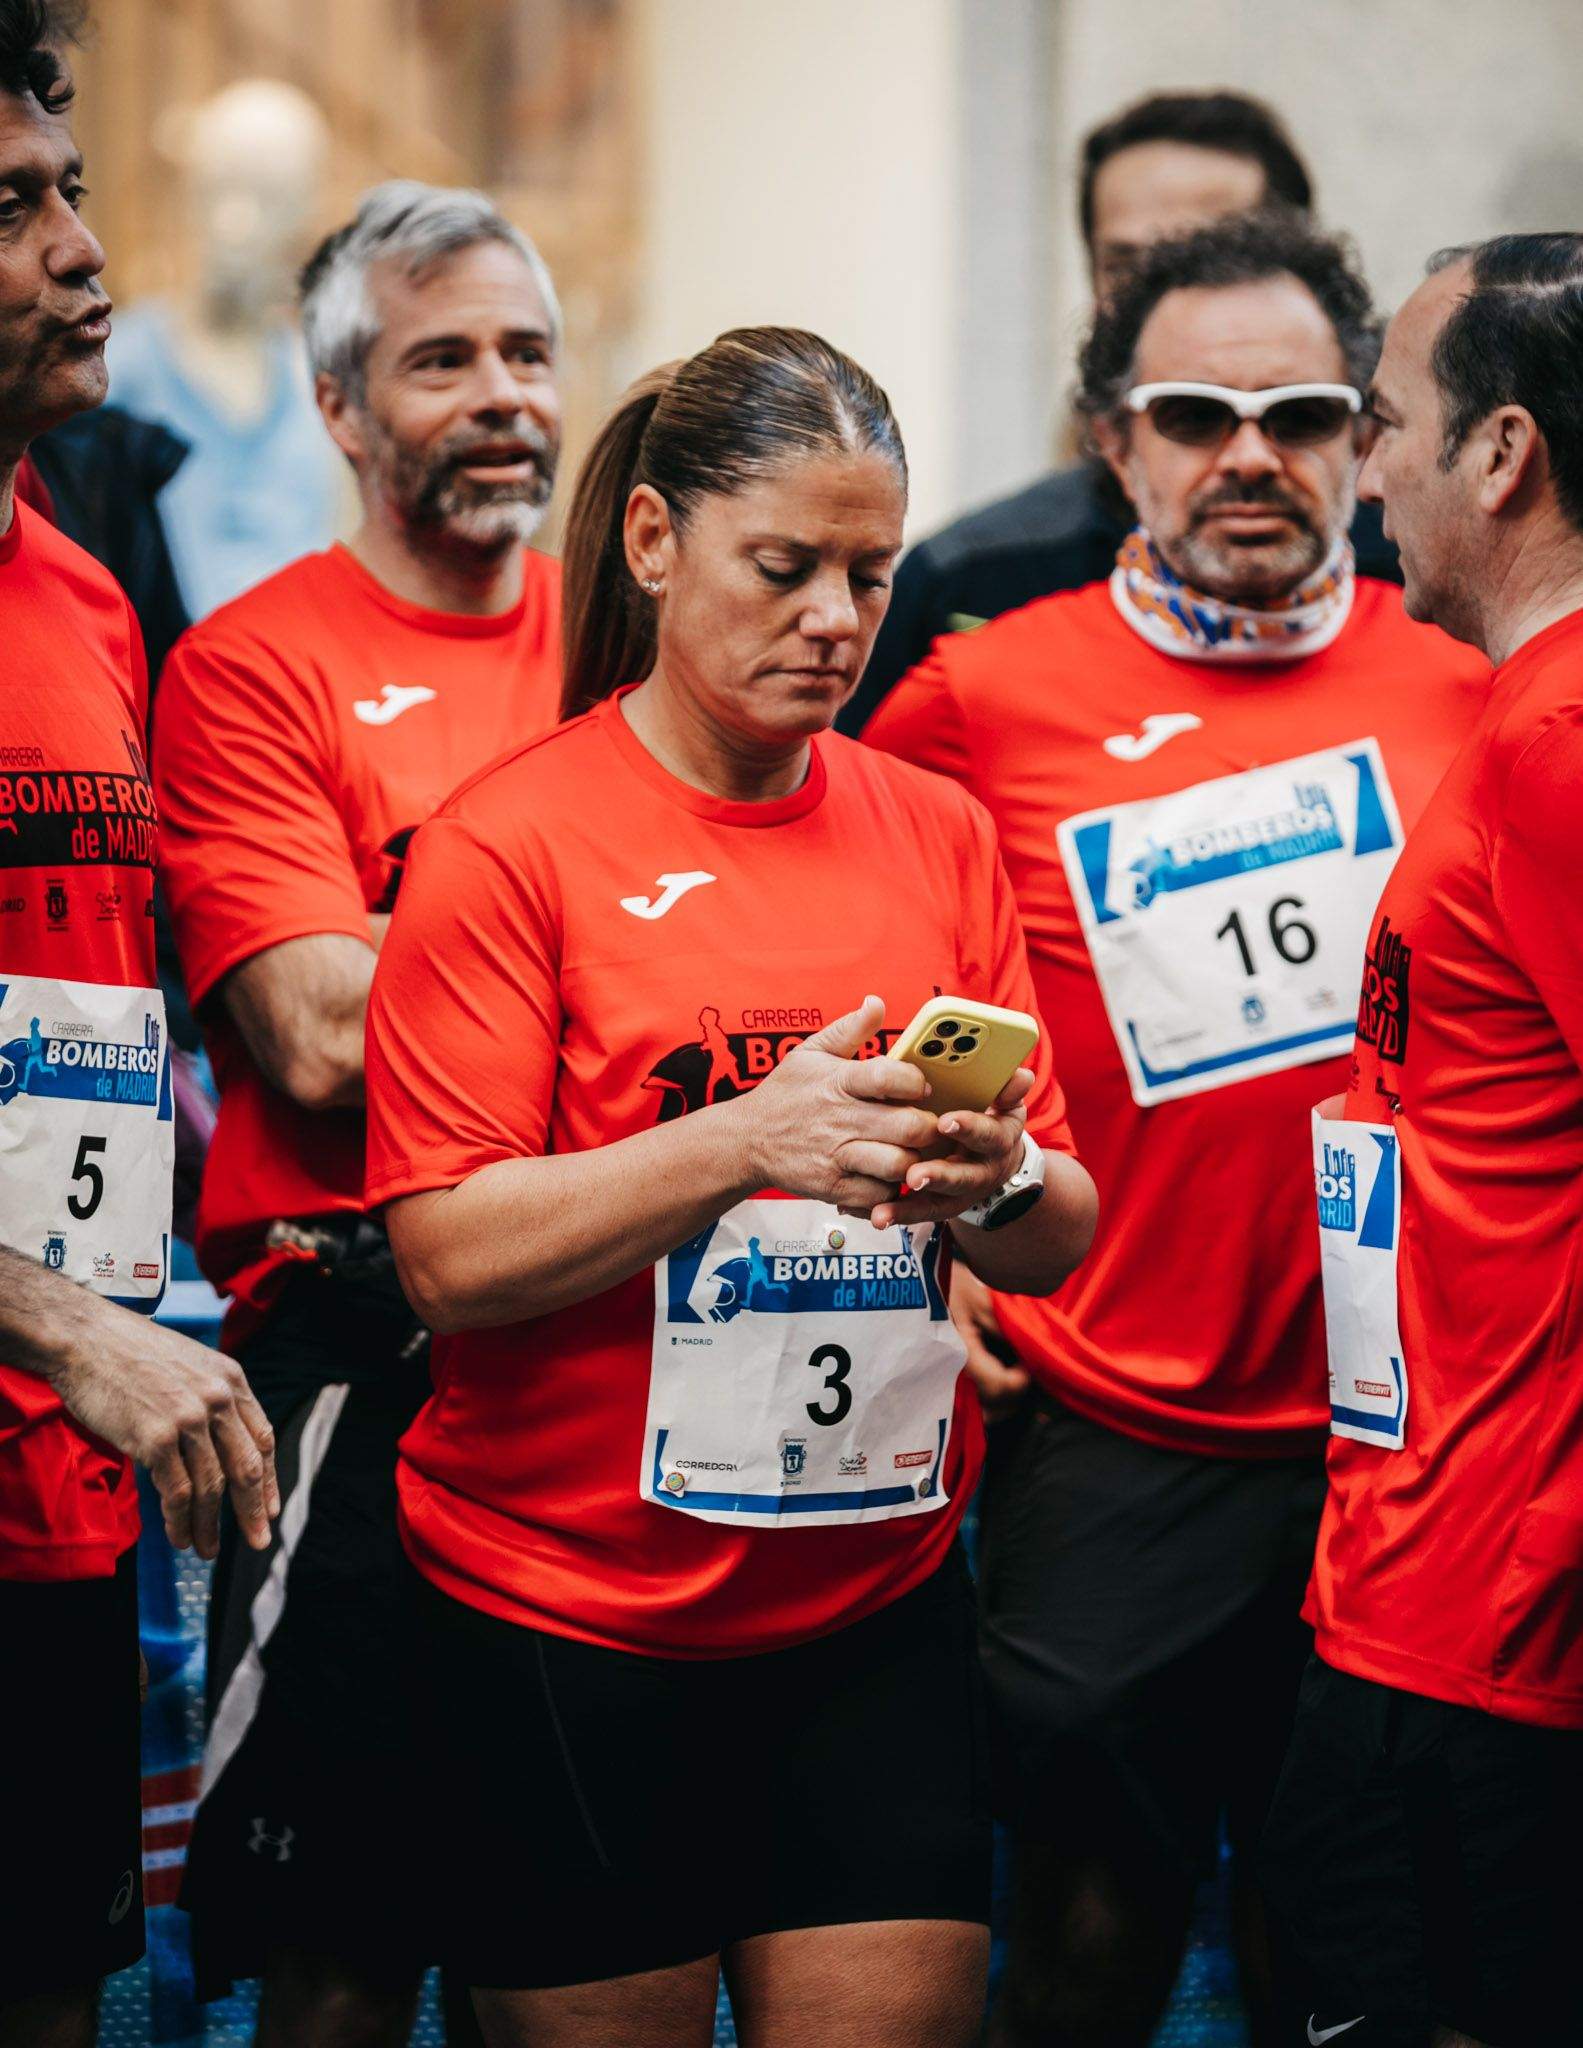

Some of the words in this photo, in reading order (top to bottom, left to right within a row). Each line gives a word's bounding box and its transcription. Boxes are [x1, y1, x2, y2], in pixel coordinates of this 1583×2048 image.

[71, 816, 99, 859] de
[1217, 895, 1318, 977] 16
[51, 1020, 94, 1038] CARRERA
[742, 1008, 823, 1028] CARRERA
[46, 1040, 158, 1075] BOMBEROS
[96, 1072, 112, 1098] de
[116, 1073, 157, 1103] MADRID
[67, 1135, 107, 1220] 5
[833, 1282, 856, 1308] de
[681, 1338, 713, 1346] MADRID
[806, 1344, 853, 1427] 3
